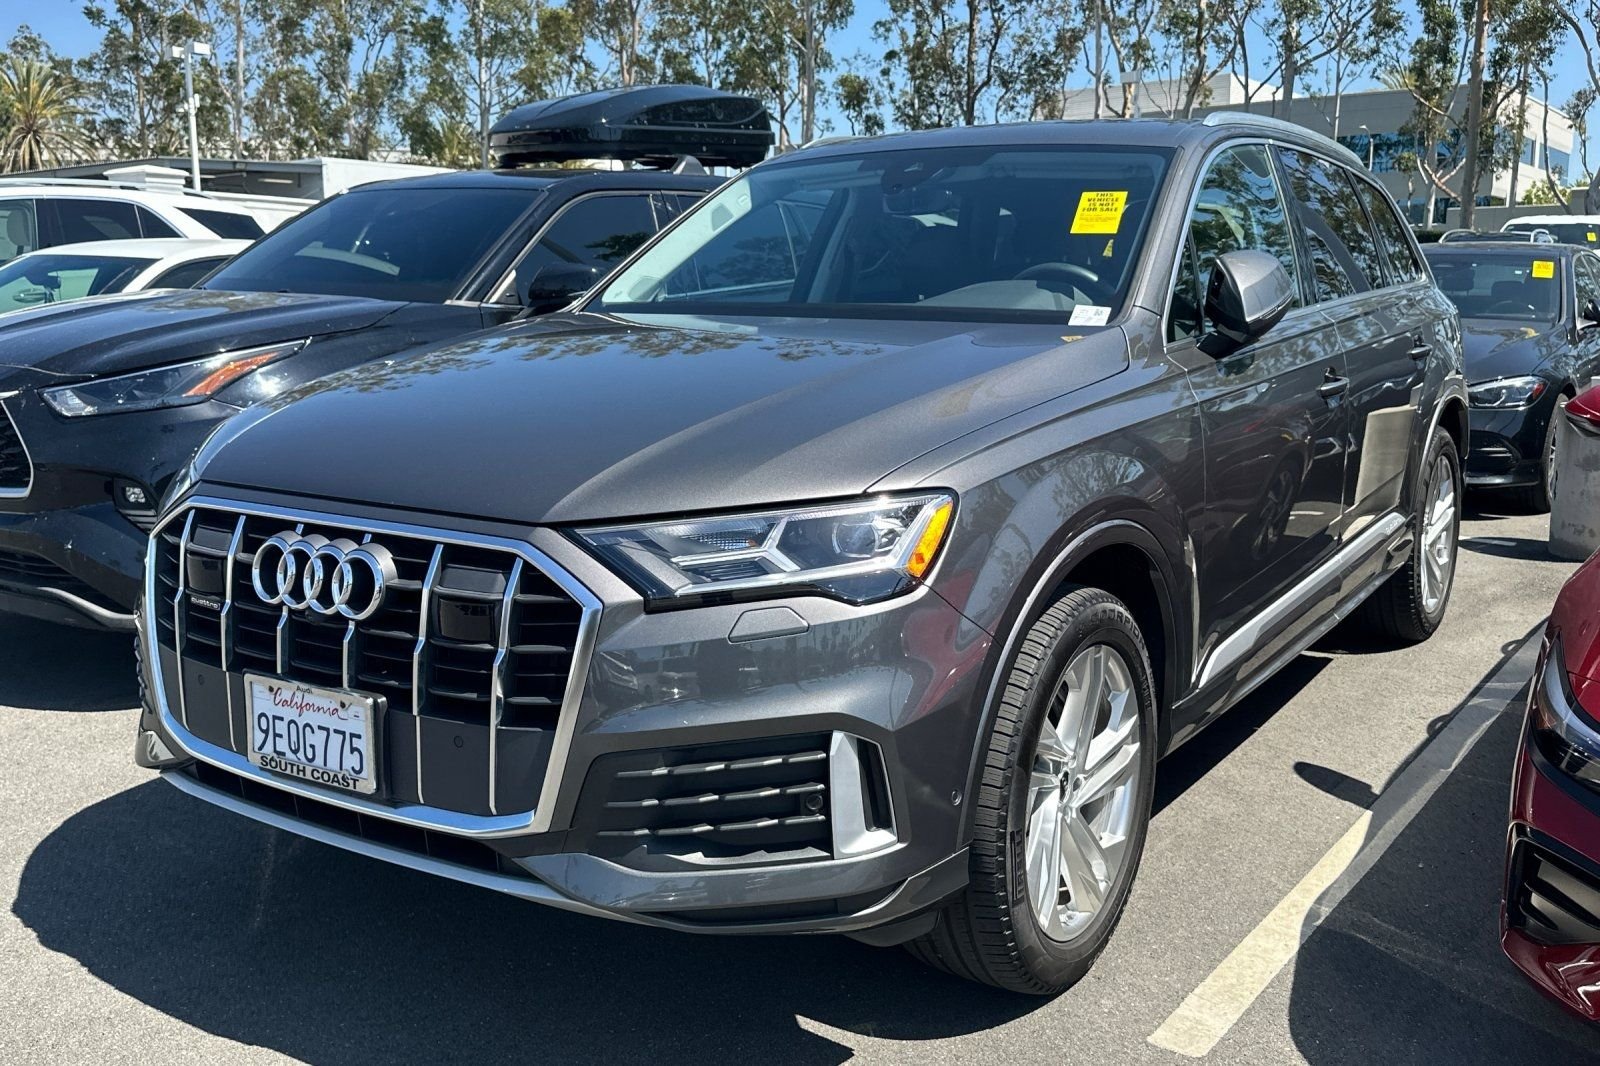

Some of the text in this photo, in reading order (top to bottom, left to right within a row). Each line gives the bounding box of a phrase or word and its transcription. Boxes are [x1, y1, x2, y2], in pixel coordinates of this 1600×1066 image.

[191, 597, 218, 608] quattro
[273, 687, 348, 720] California
[296, 685, 313, 694] Audi
[257, 712, 364, 775] 9EQG775
[260, 755, 359, 790] SOUTH COAST
